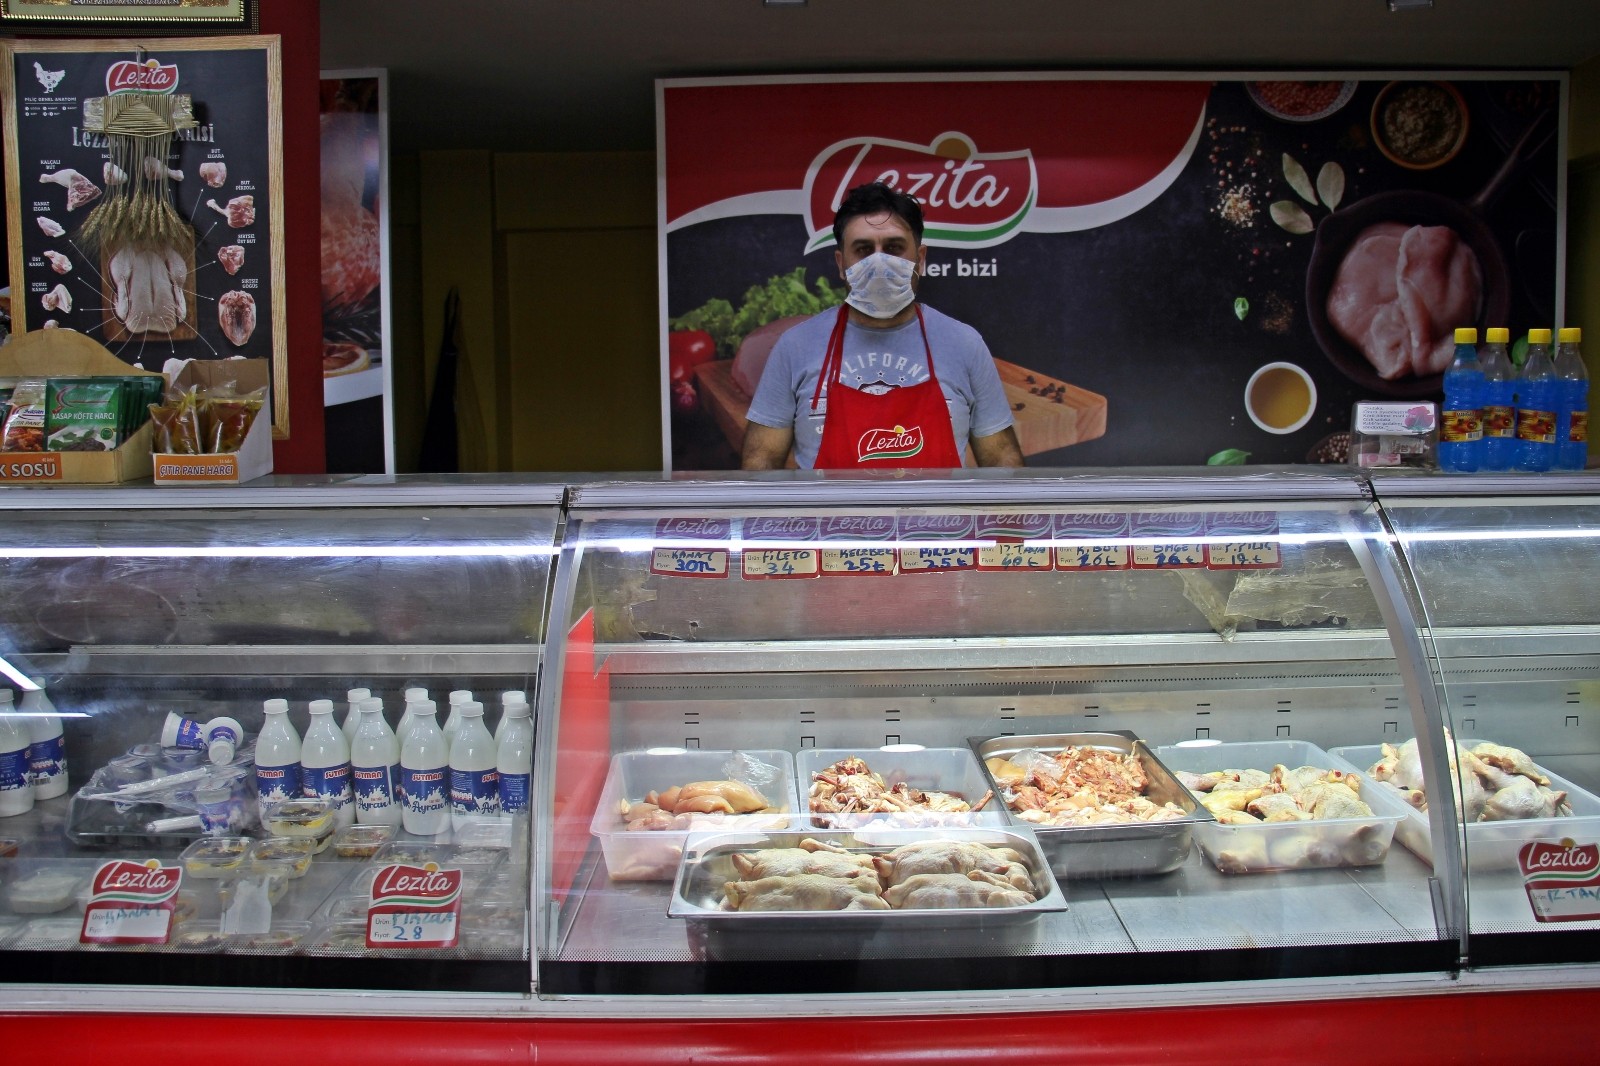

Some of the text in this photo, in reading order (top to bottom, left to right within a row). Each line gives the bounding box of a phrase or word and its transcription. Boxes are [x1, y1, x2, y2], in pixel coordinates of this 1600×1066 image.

[115, 63, 171, 87] Lezita
[922, 257, 998, 277] ler bizi
[73, 411, 94, 420] KÖFTE
[866, 430, 917, 452] Lezita
[11, 462, 56, 477] SOSU
[160, 464, 234, 478] ÇITIR PANE HARCI
[662, 518, 722, 535] Lezita
[750, 516, 810, 535] Lezita
[826, 516, 887, 532] Lezita
[412, 800, 444, 814] Ayran
[1526, 842, 1592, 870] Lezita
[100, 862, 171, 889] Lezita
[380, 866, 452, 894] Lezita
